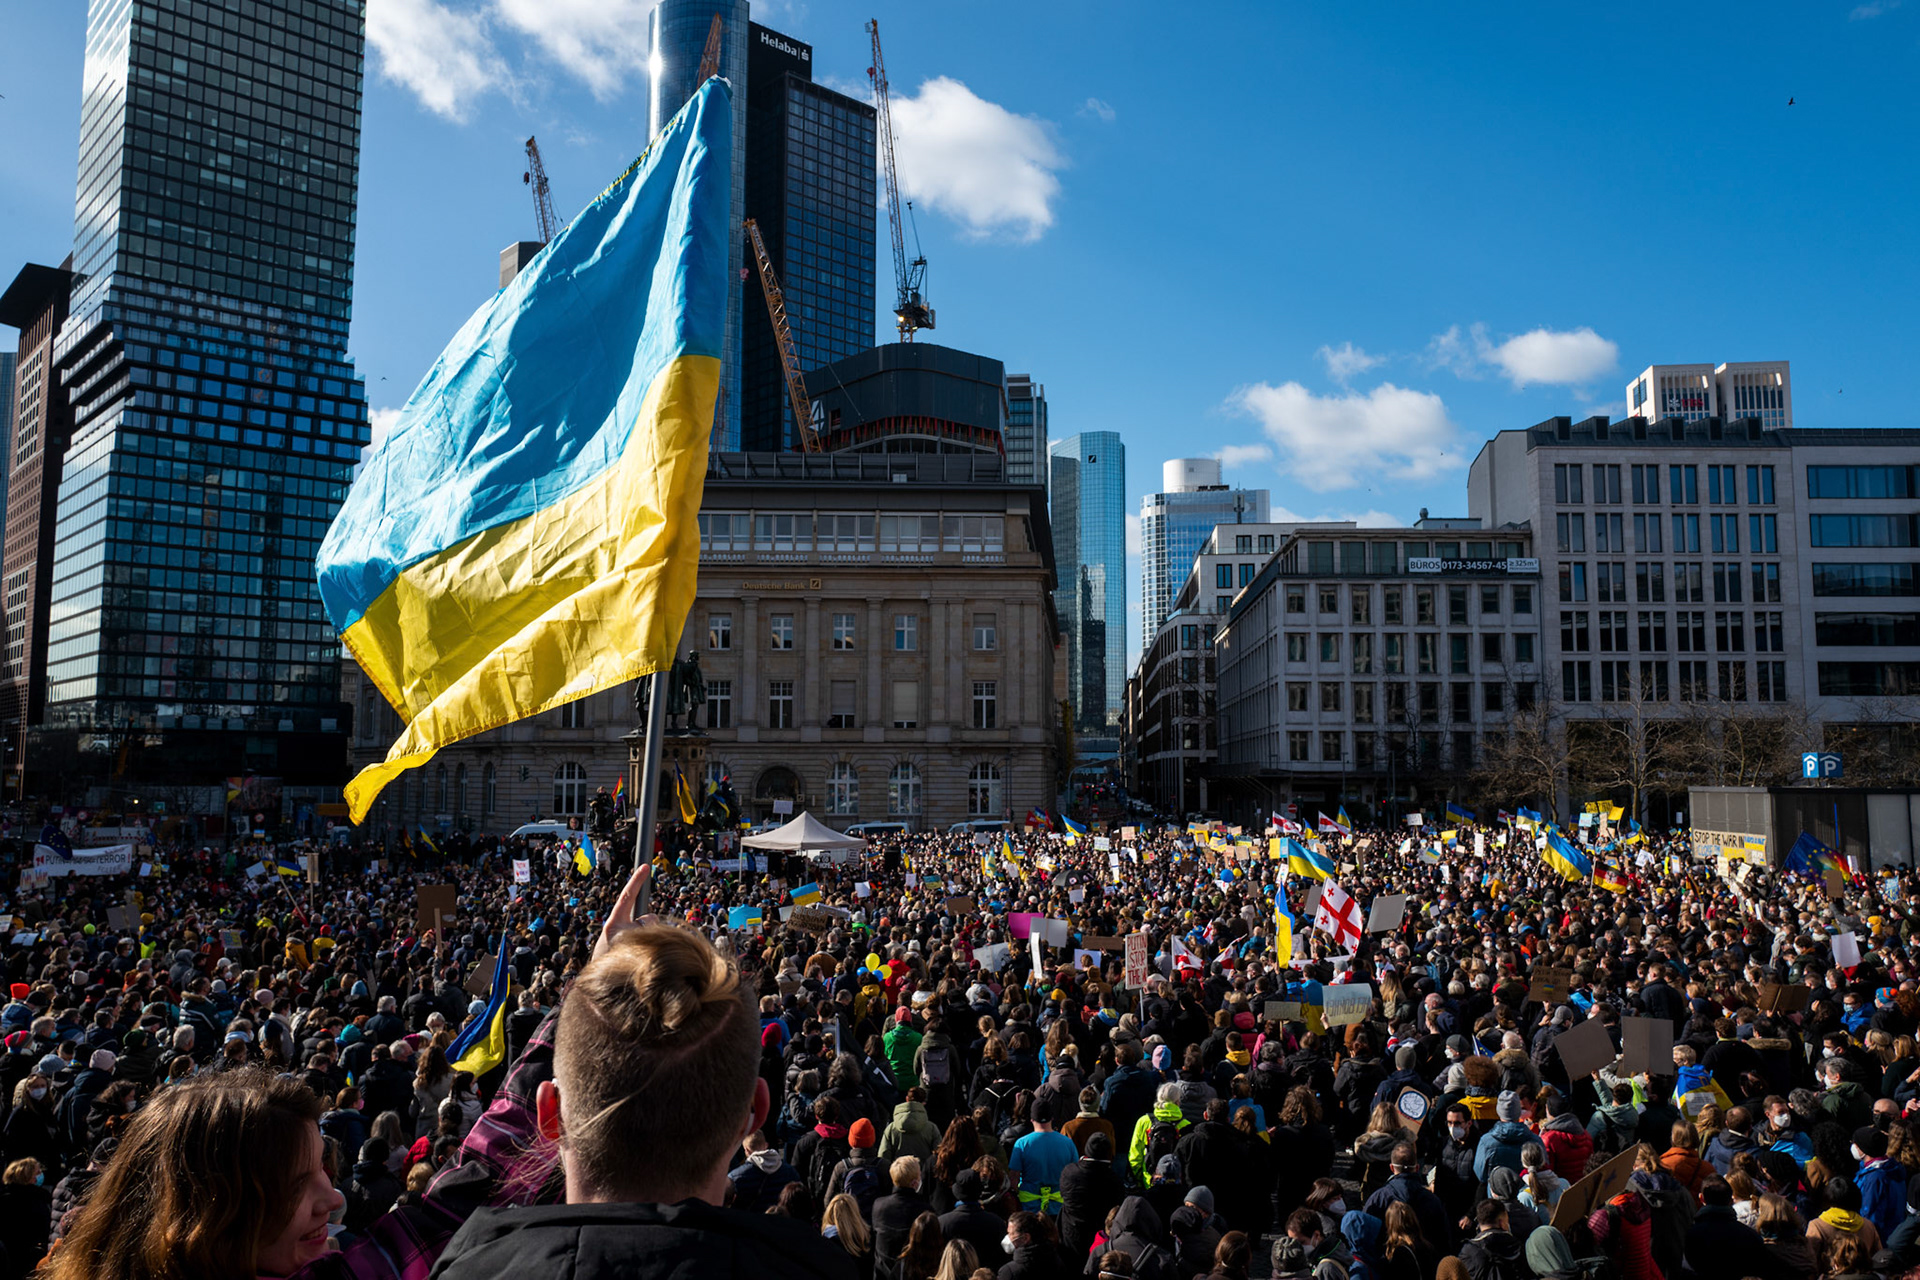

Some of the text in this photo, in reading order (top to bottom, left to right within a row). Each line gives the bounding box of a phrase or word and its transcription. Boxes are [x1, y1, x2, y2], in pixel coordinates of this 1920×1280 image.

[761, 31, 798, 57] Helaba
[1682, 398, 1704, 408] UBS
[1410, 559, 1507, 570] BÜROS 0173-34567-45
[742, 581, 805, 590] Deutsche Bank
[1806, 760, 1815, 776] P
[1824, 760, 1837, 776] P
[1694, 831, 1710, 844] STOP
[1711, 833, 1721, 846] THE
[1721, 834, 1737, 848] WAR
[1127, 935, 1147, 951] PUTIN
[1129, 950, 1146, 968] STOP
[1127, 967, 1141, 985] THE
